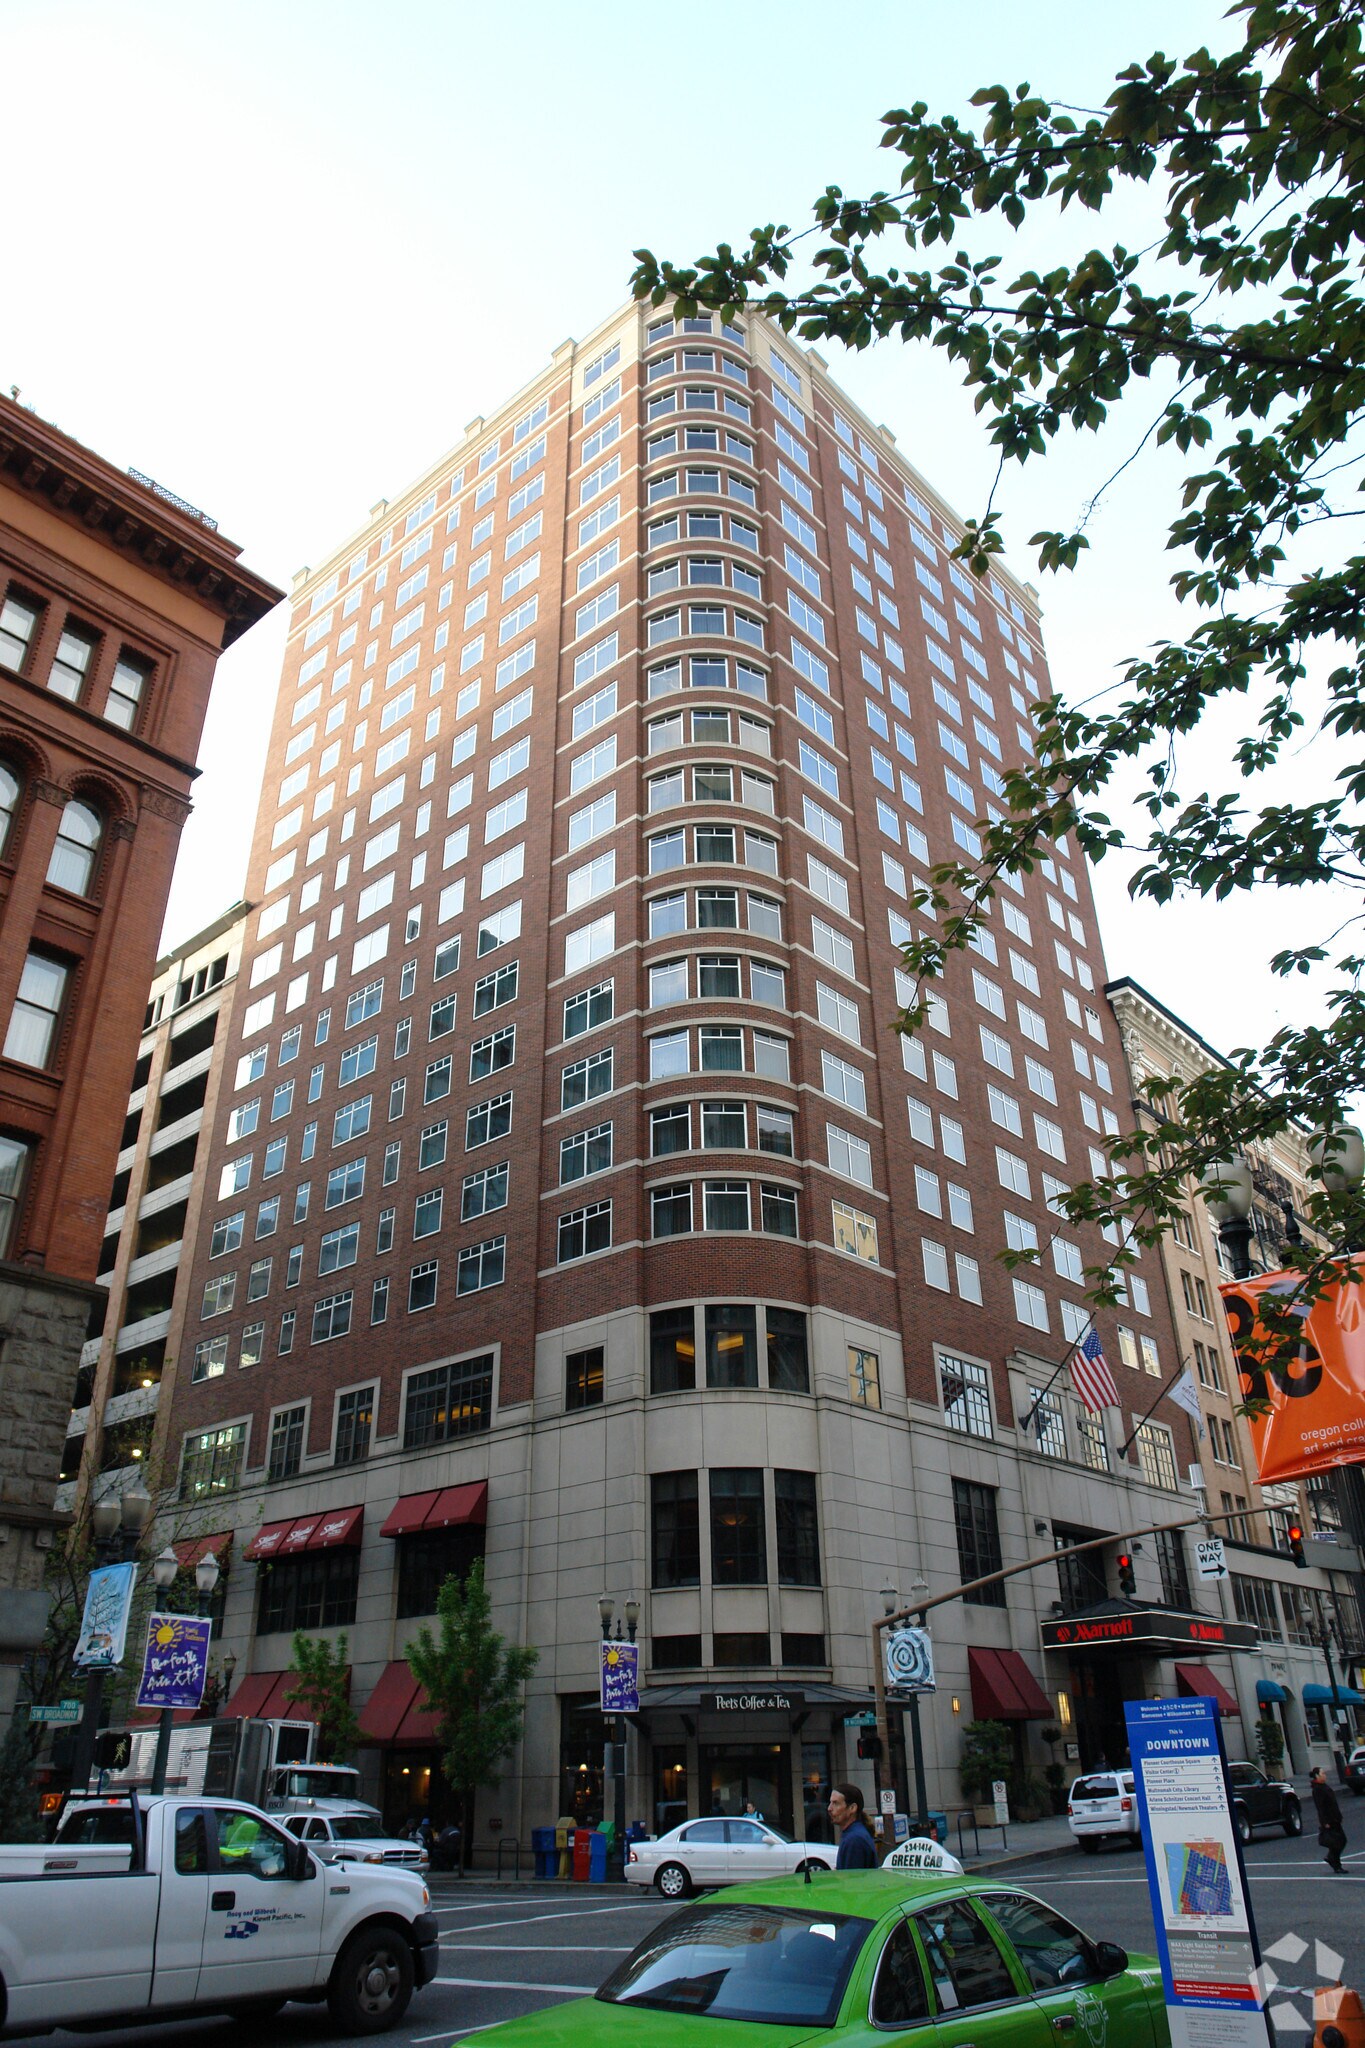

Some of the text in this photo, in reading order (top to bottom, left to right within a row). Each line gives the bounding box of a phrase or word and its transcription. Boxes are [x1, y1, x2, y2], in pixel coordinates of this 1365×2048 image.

[1300, 1417, 1365, 1440] oregon coll
[1303, 1442, 1319, 1455] art
[1197, 1541, 1222, 1553] ONE
[1199, 1552, 1222, 1563] WAY
[1073, 1619, 1133, 1642] Marriott
[740, 1695, 766, 1710] Coffee
[767, 1698, 775, 1707] &
[774, 1694, 790, 1708] Tea
[31, 1710, 77, 1719] SW BROADWAY
[1146, 1737, 1210, 1751] DOWNTOWN
[904, 1843, 932, 1852] 234-1414
[891, 1854, 943, 1868] GREEN CAB
[1197, 1931, 1218, 1939] Transit
